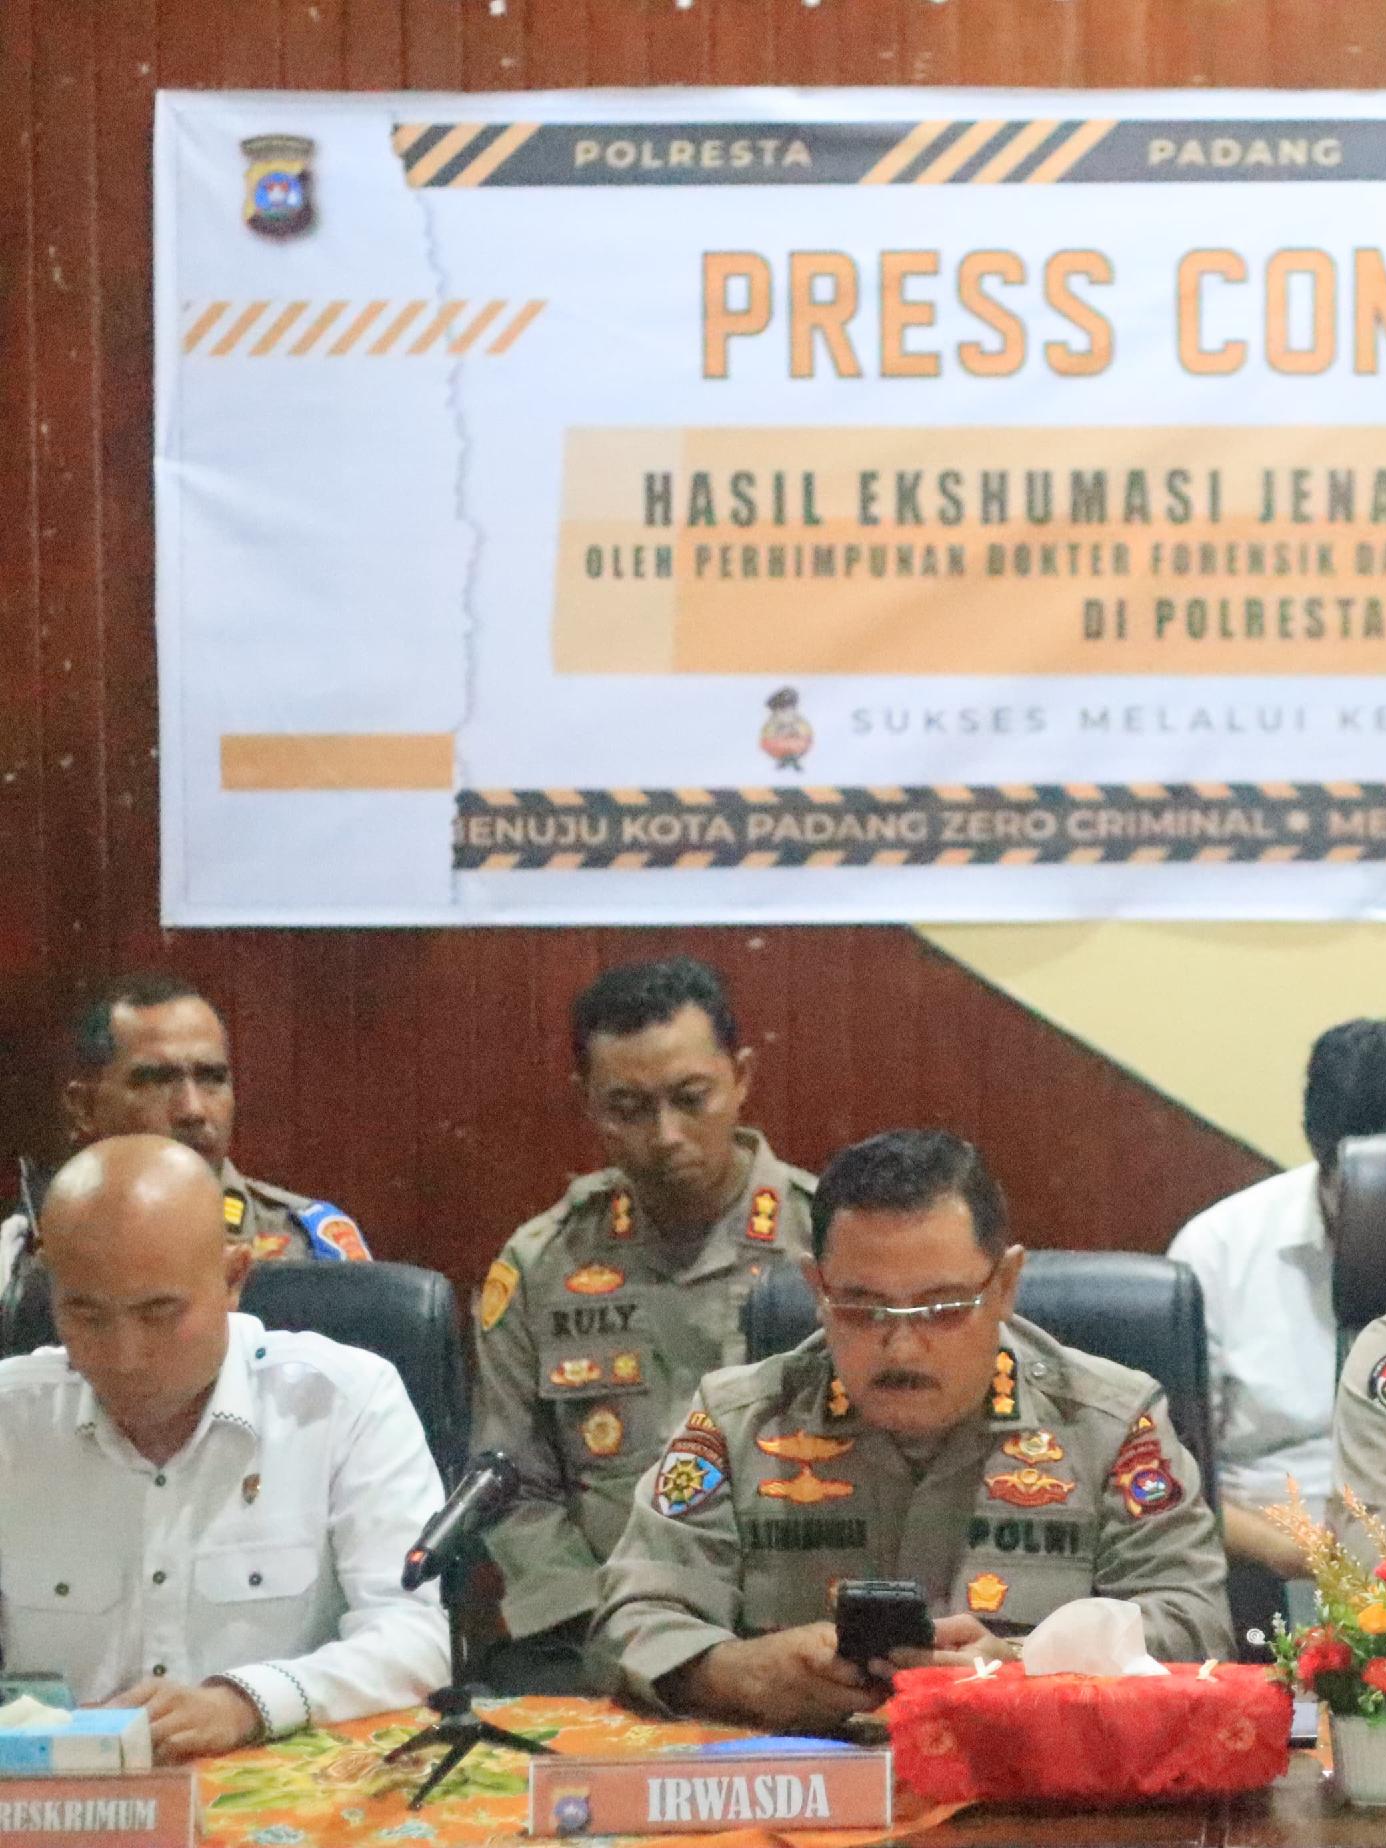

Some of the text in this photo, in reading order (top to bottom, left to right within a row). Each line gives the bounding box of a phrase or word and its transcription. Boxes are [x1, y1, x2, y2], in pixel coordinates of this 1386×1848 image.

[573, 138, 813, 169] POLRESTA
[1147, 137, 1343, 167] PADANG
[702, 248, 1115, 379] PRESS
[643, 469, 823, 528] HASIL
[858, 468, 1221, 526] EKSHUMASI
[585, 543, 674, 579] OLEH
[694, 543, 967, 579] PERHIMPUNAN
[985, 542, 1130, 577] DOKTER
[1151, 541, 1336, 577] FORENSIK
[1083, 597, 1128, 640] DI
[1154, 597, 1386, 640] POLRESTA
[850, 707, 1049, 734] SUKSES
[1079, 706, 1306, 734] MELALUI
[621, 812, 736, 846] KOTA
[746, 811, 930, 844] PADANG
[939, 809, 1057, 842] ZERO
[1066, 807, 1276, 840] CRIMINAL
[552, 1304, 638, 1338] RULY
[646, 1774, 832, 1823] IRWASDA
